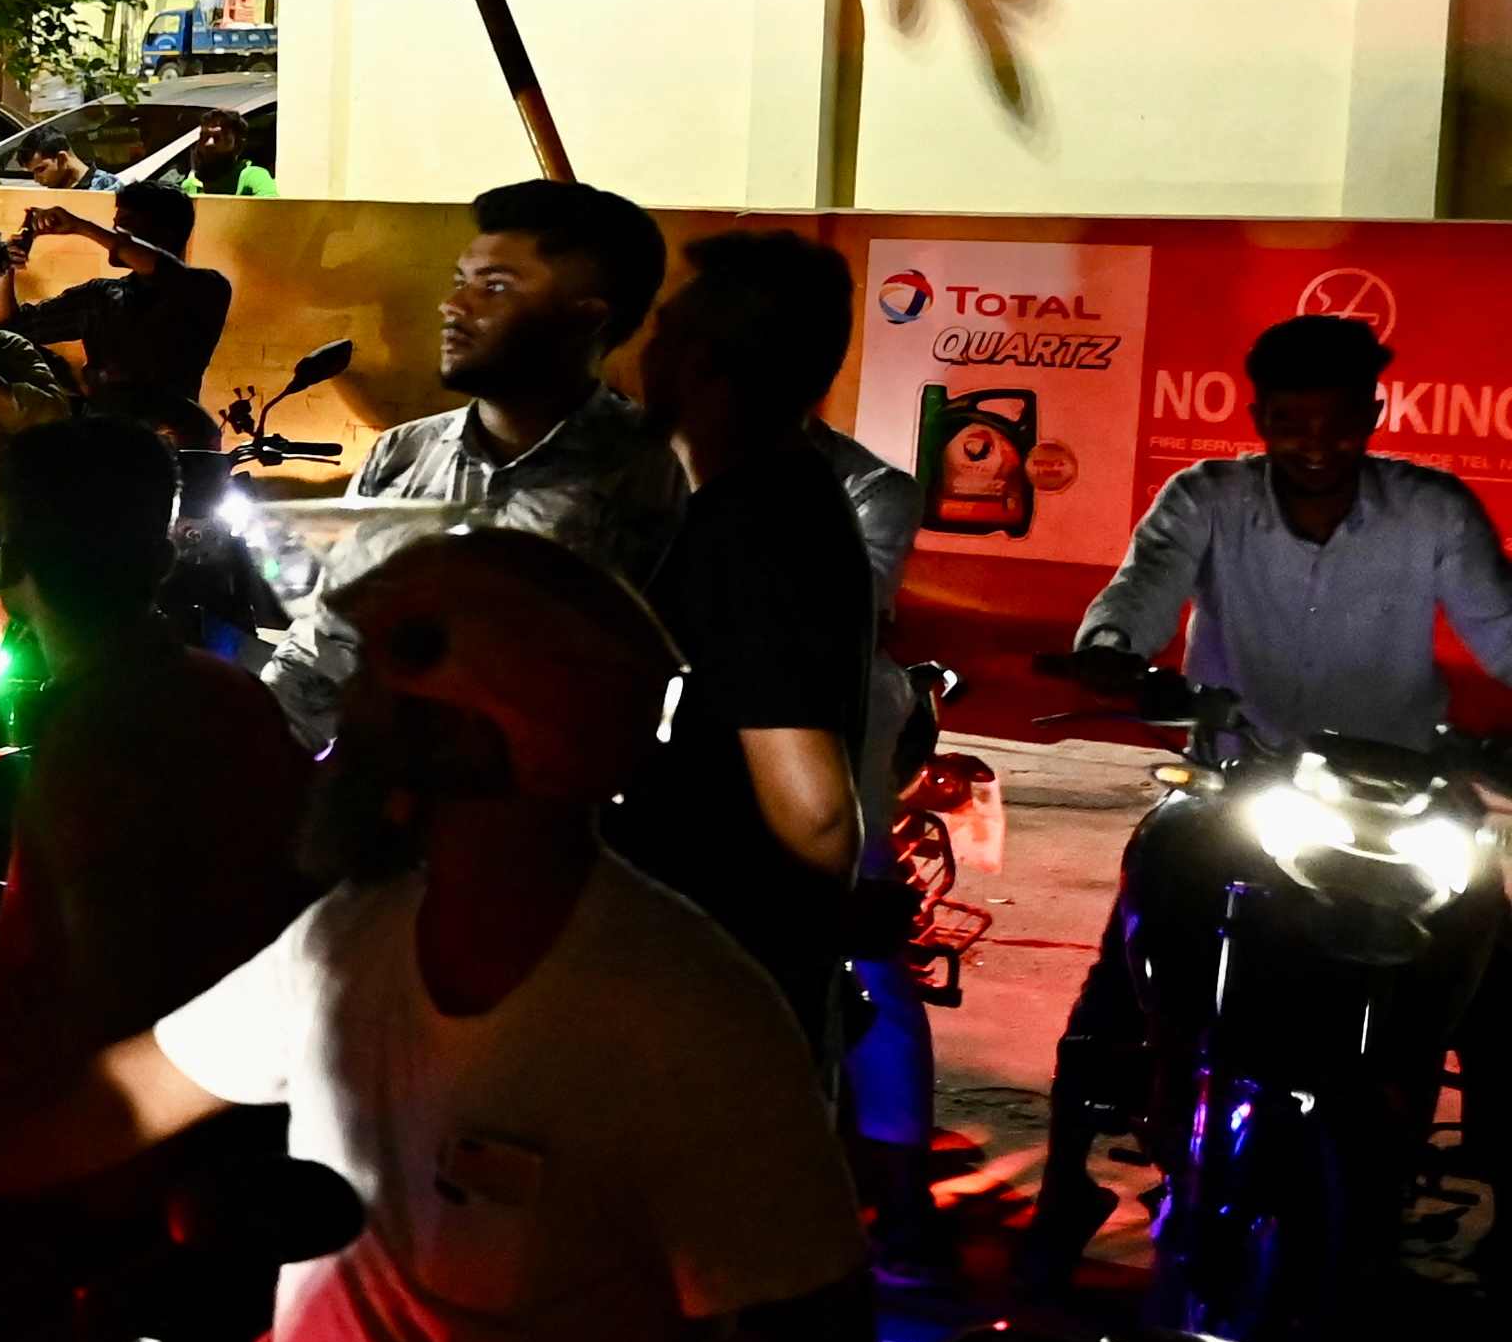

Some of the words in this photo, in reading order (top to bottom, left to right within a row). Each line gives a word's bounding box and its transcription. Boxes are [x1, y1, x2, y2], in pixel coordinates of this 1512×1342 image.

[945, 285, 1102, 321] TOTAL
[932, 325, 1122, 370] QUARTZ
[1152, 369, 1238, 423] NO
